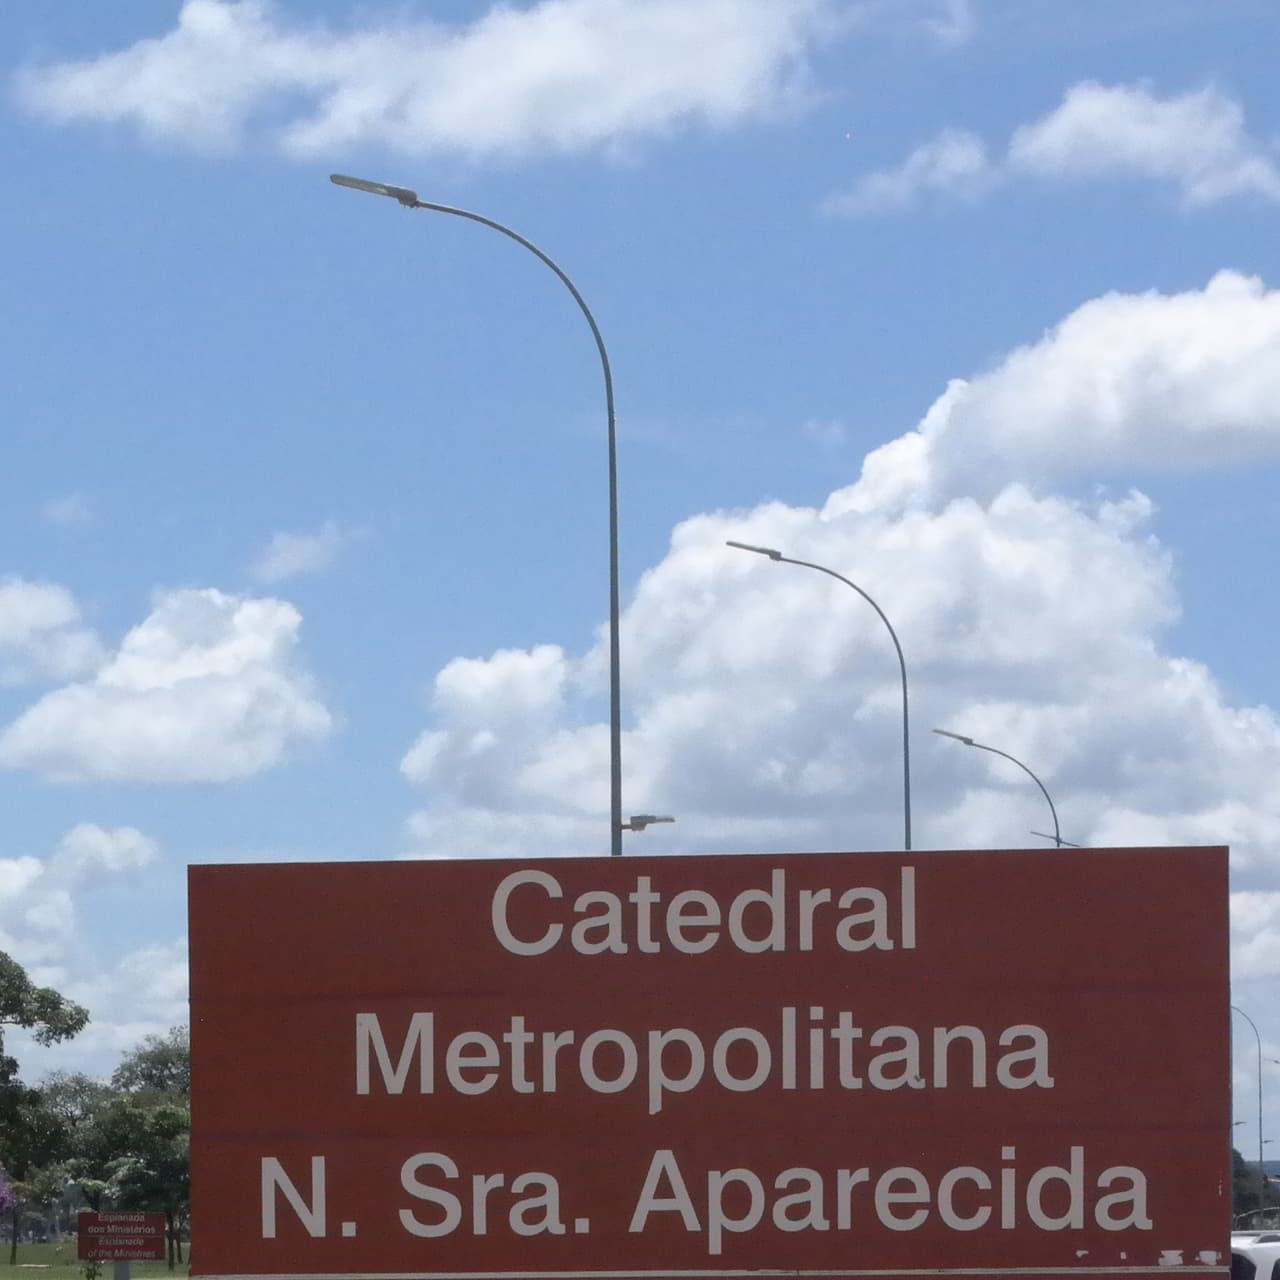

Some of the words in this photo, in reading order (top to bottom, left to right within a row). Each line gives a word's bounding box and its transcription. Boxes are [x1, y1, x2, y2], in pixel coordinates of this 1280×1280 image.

[490, 866, 919, 957] Catedral
[355, 1005, 1055, 1114] Metropolitana
[88, 1225, 105, 1233] dos
[98, 1212, 145, 1223] Esplanada
[261, 1156, 357, 1240] N.
[398, 1150, 590, 1239] Sra.
[630, 1144, 1153, 1255] Aparecida
